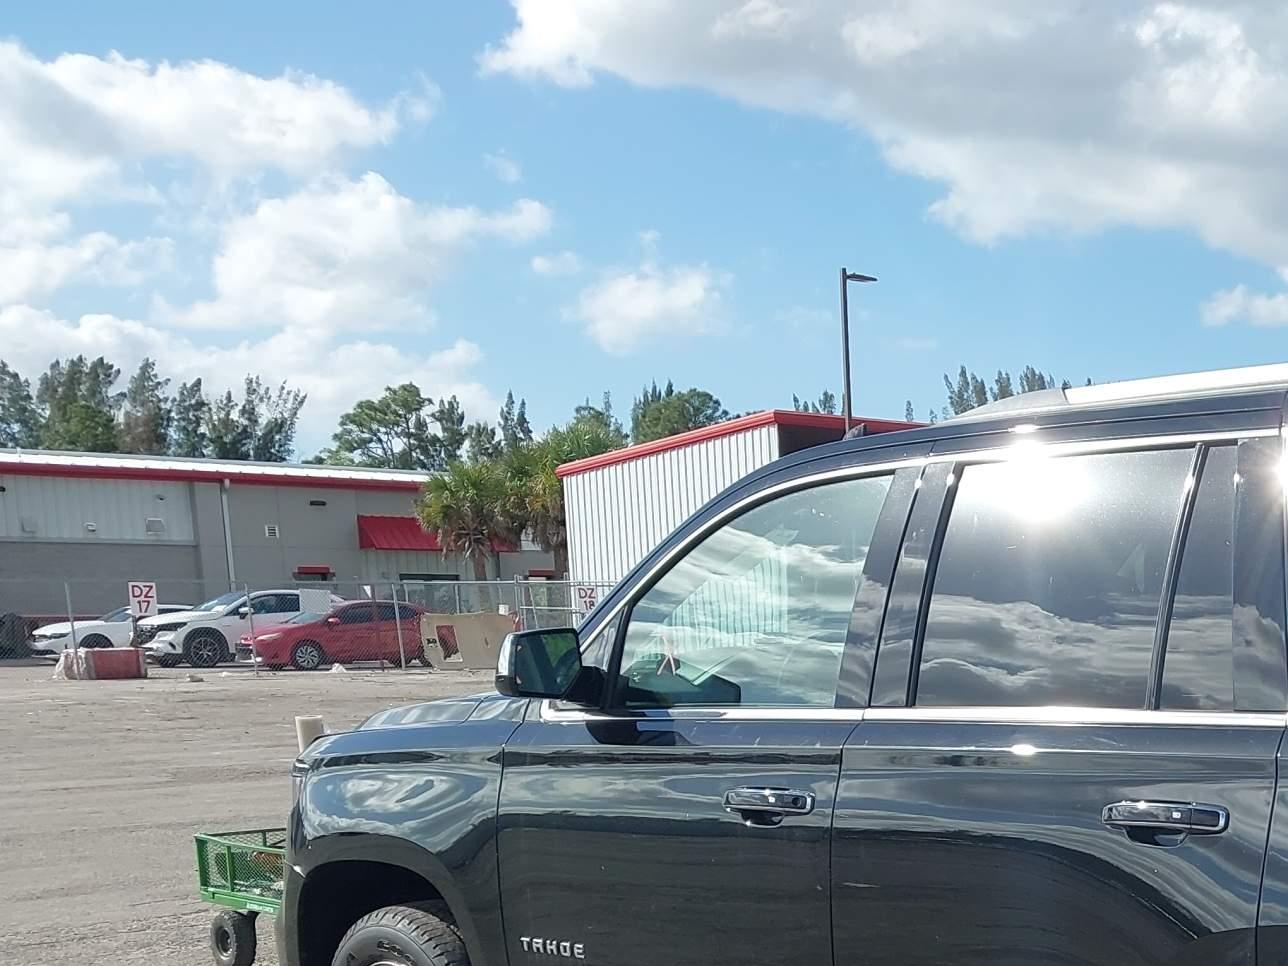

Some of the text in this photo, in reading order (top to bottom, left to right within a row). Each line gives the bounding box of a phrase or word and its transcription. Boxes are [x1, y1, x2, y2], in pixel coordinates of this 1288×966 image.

[131, 584, 155, 599] DZ
[577, 587, 596, 599] DZ
[137, 600, 151, 613] 17
[583, 600, 595, 611] 18
[519, 936, 586, 959] TAHOE
